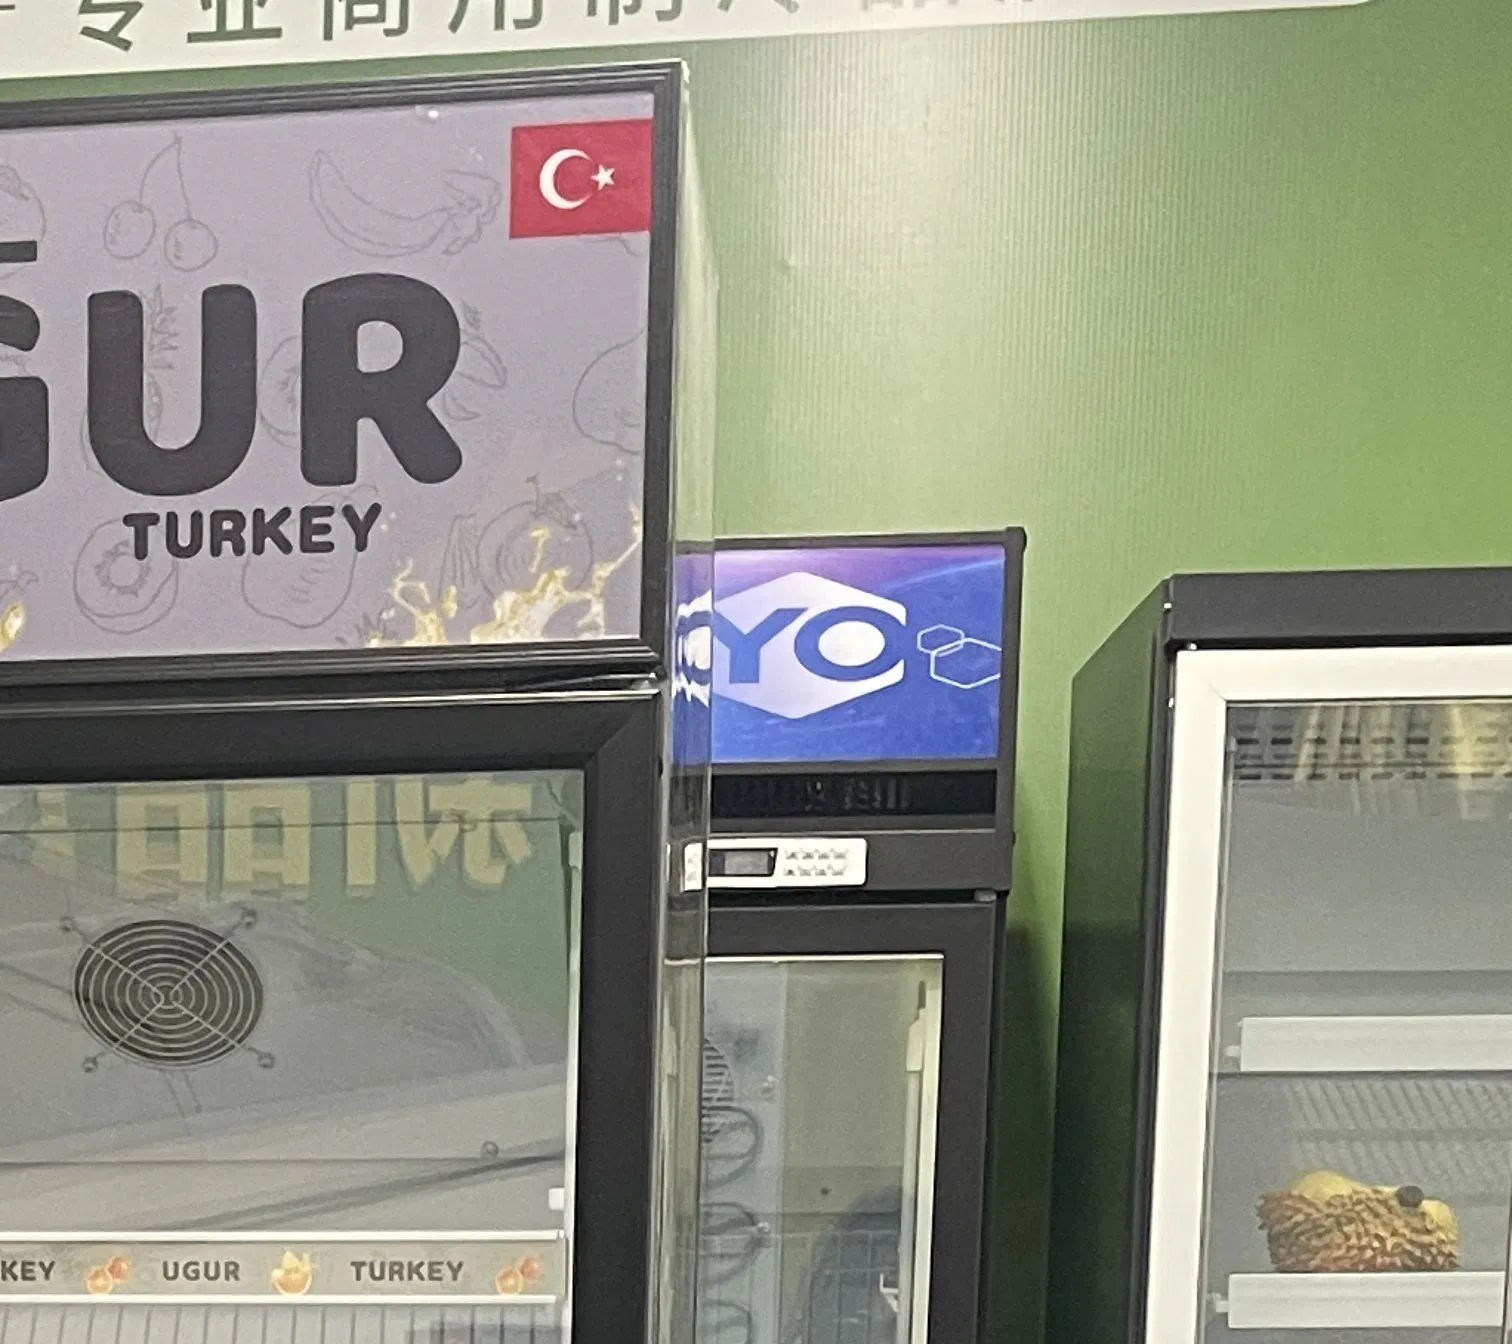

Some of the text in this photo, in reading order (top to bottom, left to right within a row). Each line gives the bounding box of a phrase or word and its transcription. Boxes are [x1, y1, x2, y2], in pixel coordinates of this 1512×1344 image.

[122, 501, 383, 562] TURKEY
[162, 1260, 240, 1282] UGUR
[350, 1260, 464, 1282] TURKEY
